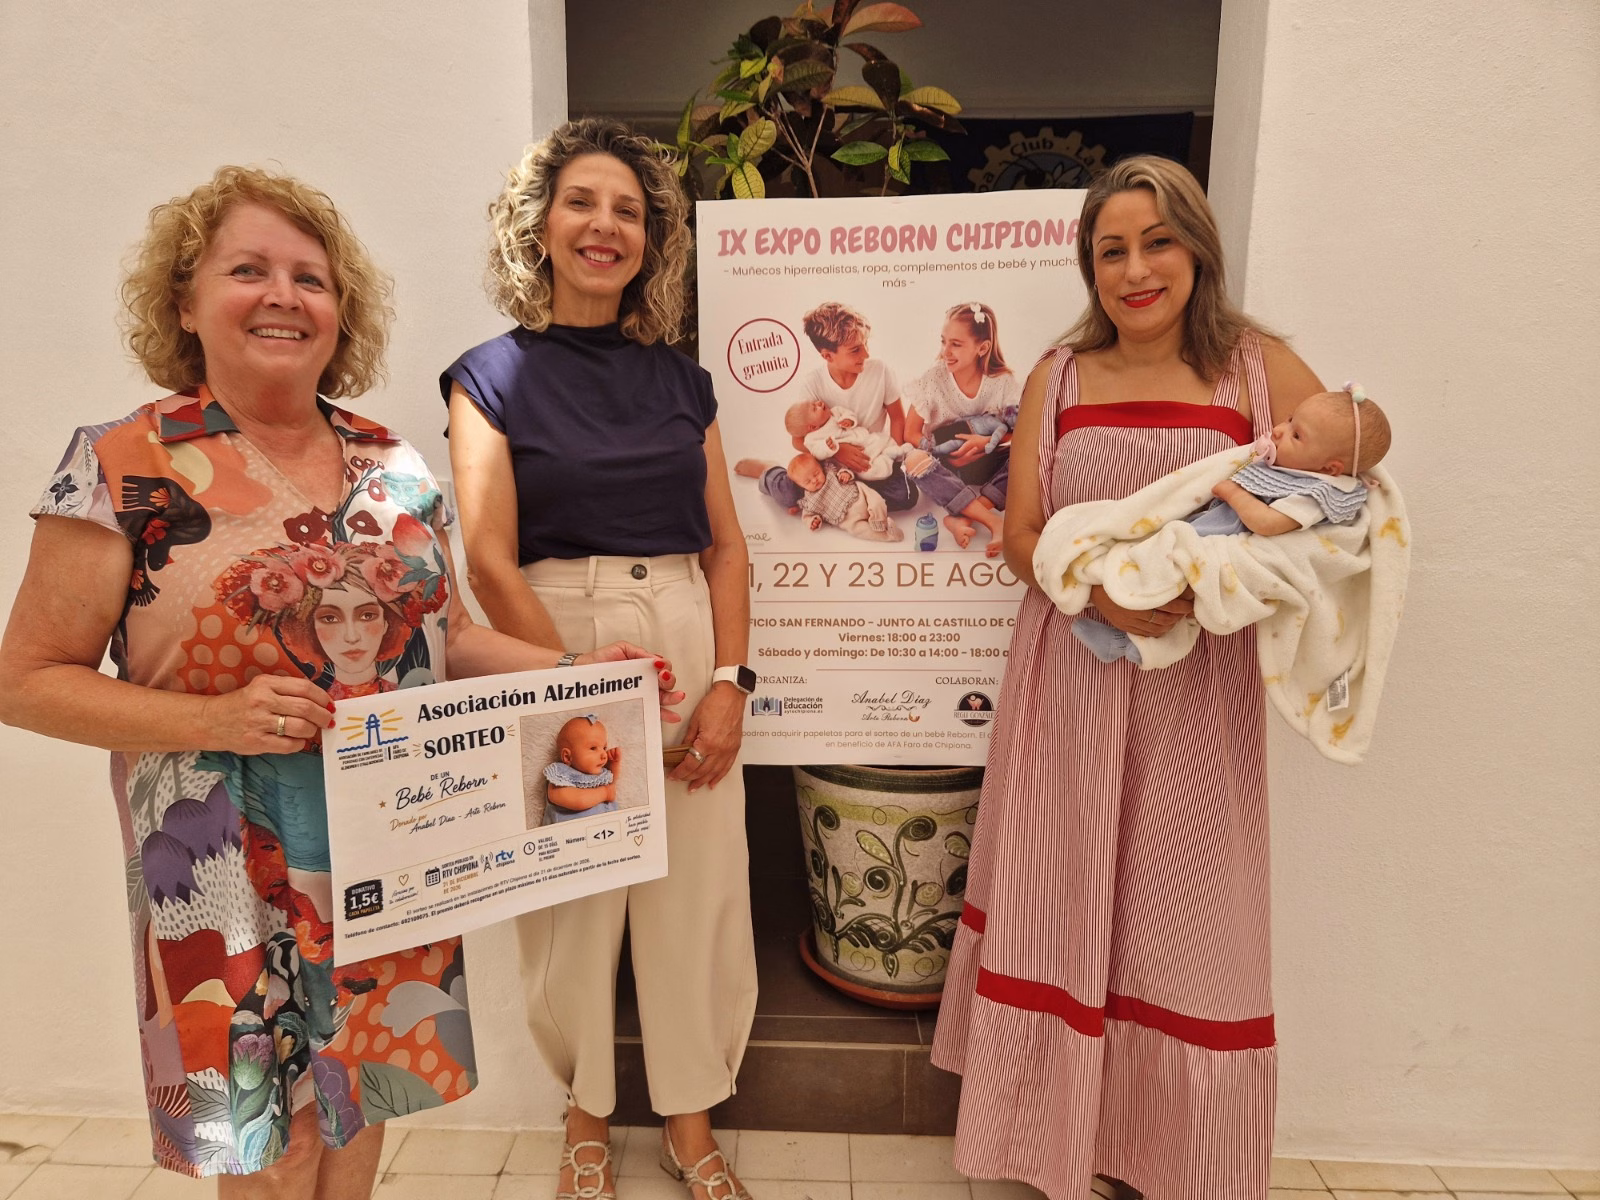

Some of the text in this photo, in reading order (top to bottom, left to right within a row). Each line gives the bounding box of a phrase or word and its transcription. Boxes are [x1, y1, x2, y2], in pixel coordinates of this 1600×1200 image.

[1010, 138, 1054, 156] Club
[717, 228, 748, 257] IX
[754, 227, 821, 255] EXPO
[830, 224, 938, 255] REBORN
[732, 265, 781, 276] Muñecos
[784, 264, 860, 277] hiperrealistas,
[862, 264, 890, 275] ropa,
[893, 262, 978, 274] complementos
[980, 260, 995, 269] de
[998, 258, 1027, 269] bebé
[1030, 260, 1037, 270] y
[882, 278, 907, 288] más
[737, 331, 783, 355] Entrada
[743, 356, 789, 380] gratuita
[773, 562, 809, 587] 22
[819, 563, 838, 587] Y
[848, 562, 885, 587] 23
[897, 562, 934, 587] DE
[779, 618, 803, 627] SAN
[805, 618, 866, 627] FERNANDO
[877, 618, 915, 627] JUNTO
[917, 618, 931, 627] AL
[933, 618, 987, 627] CASTILLO
[990, 618, 1004, 627] DE
[838, 633, 961, 642] Viernes: 18:00 a 23:00
[758, 647, 802, 657] Sábado
[804, 649, 811, 660] y
[813, 647, 868, 660] domingo:
[870, 647, 885, 657] De
[887, 648, 917, 657] 10:30
[919, 649, 927, 657] a
[928, 648, 959, 657] 14:00
[970, 648, 1000, 657] 18:00
[756, 676, 808, 684] ORGANIZA:
[935, 677, 999, 685] COLABORAN:
[417, 675, 643, 723] Asociación Alzheimer
[851, 690, 898, 704] Anabel
[881, 712, 908, 721] Reborn
[424, 725, 505, 758] SORTEO
[771, 730, 801, 738] adquirir
[803, 730, 842, 738] papeletas
[947, 731, 977, 739] Reborn.
[837, 740, 873, 748] beneficio
[935, 741, 972, 750] Chipiona.
[395, 775, 488, 810] Bebé Reborn
[408, 818, 436, 834] Anabel
[593, 829, 615, 840] <1>
[495, 850, 514, 862] rtv
[442, 860, 479, 879] RTV CHIPIONA
[350, 892, 379, 910] 1,5€
